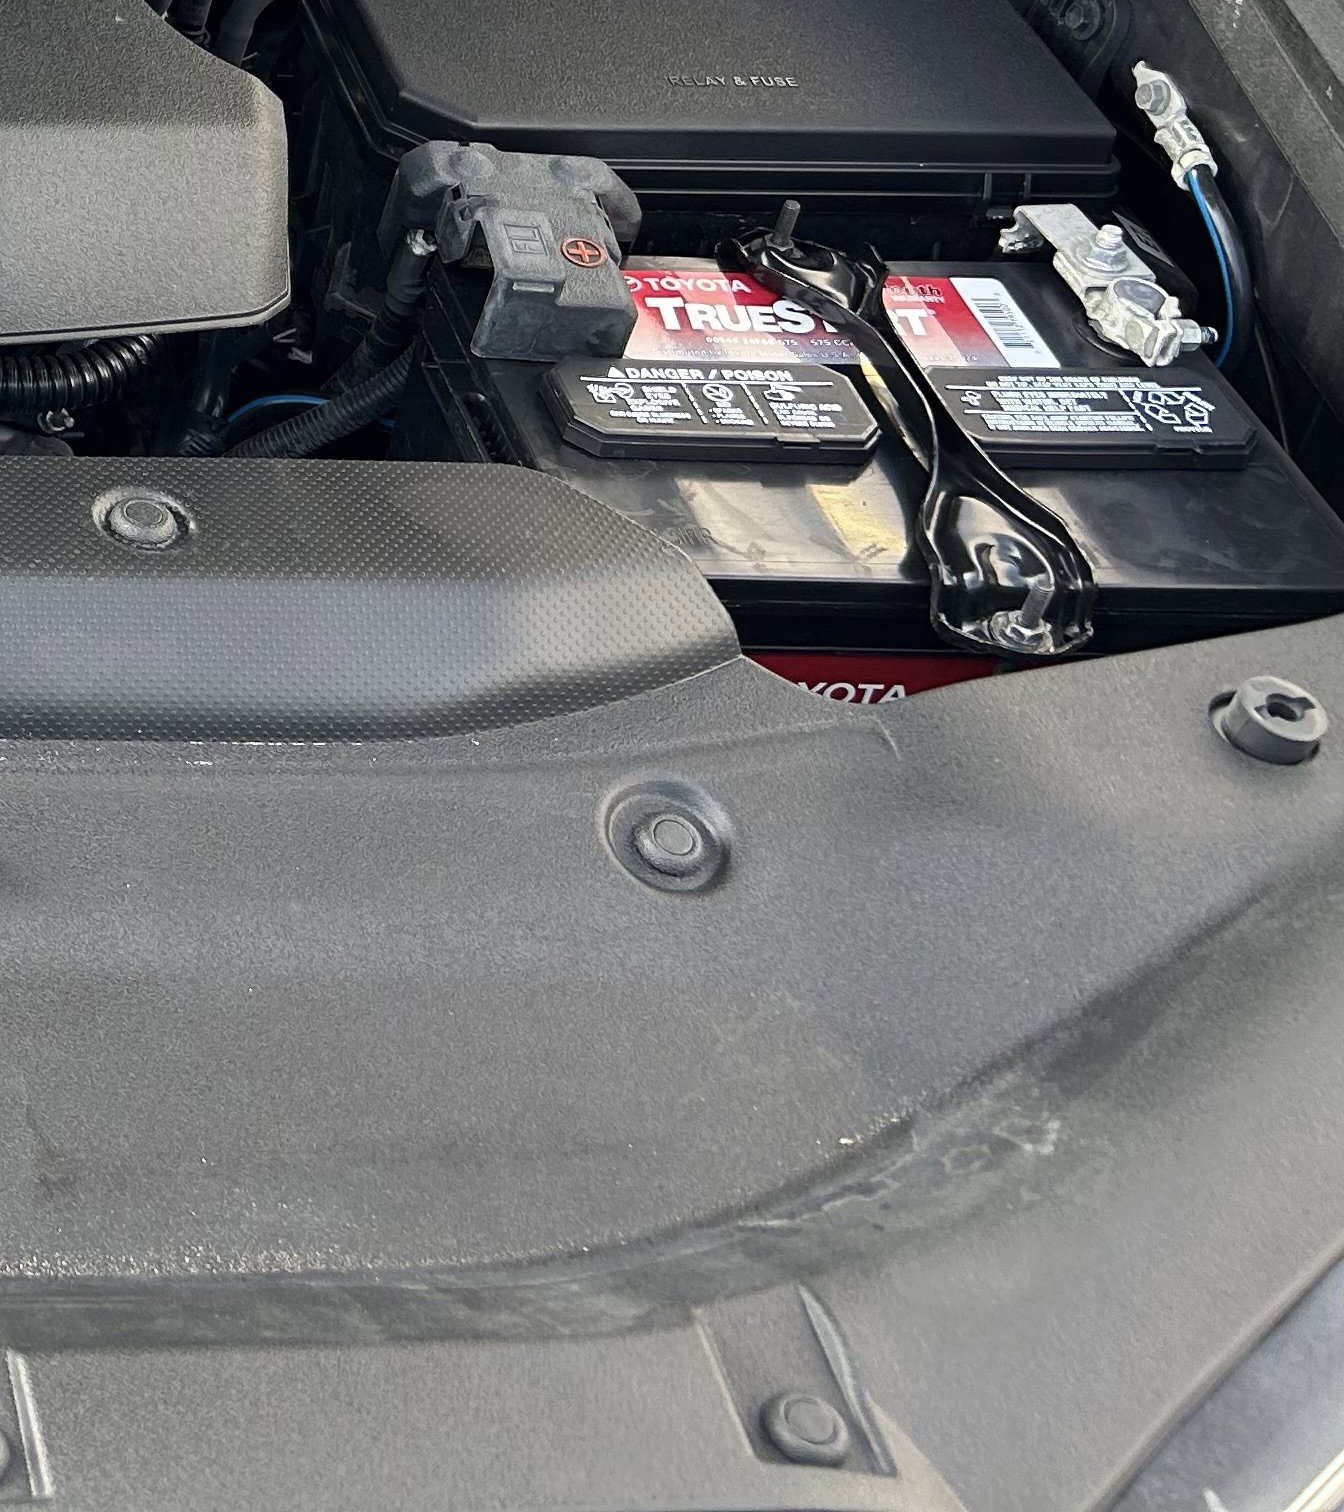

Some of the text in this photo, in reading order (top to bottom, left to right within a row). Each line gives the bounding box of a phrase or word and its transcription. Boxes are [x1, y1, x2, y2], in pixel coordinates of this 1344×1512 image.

[665, 76, 799, 87] RELAY & FUSE
[642, 277, 752, 293] TOYOTA
[625, 368, 705, 380] DANGER
[720, 369, 794, 382] POISON
